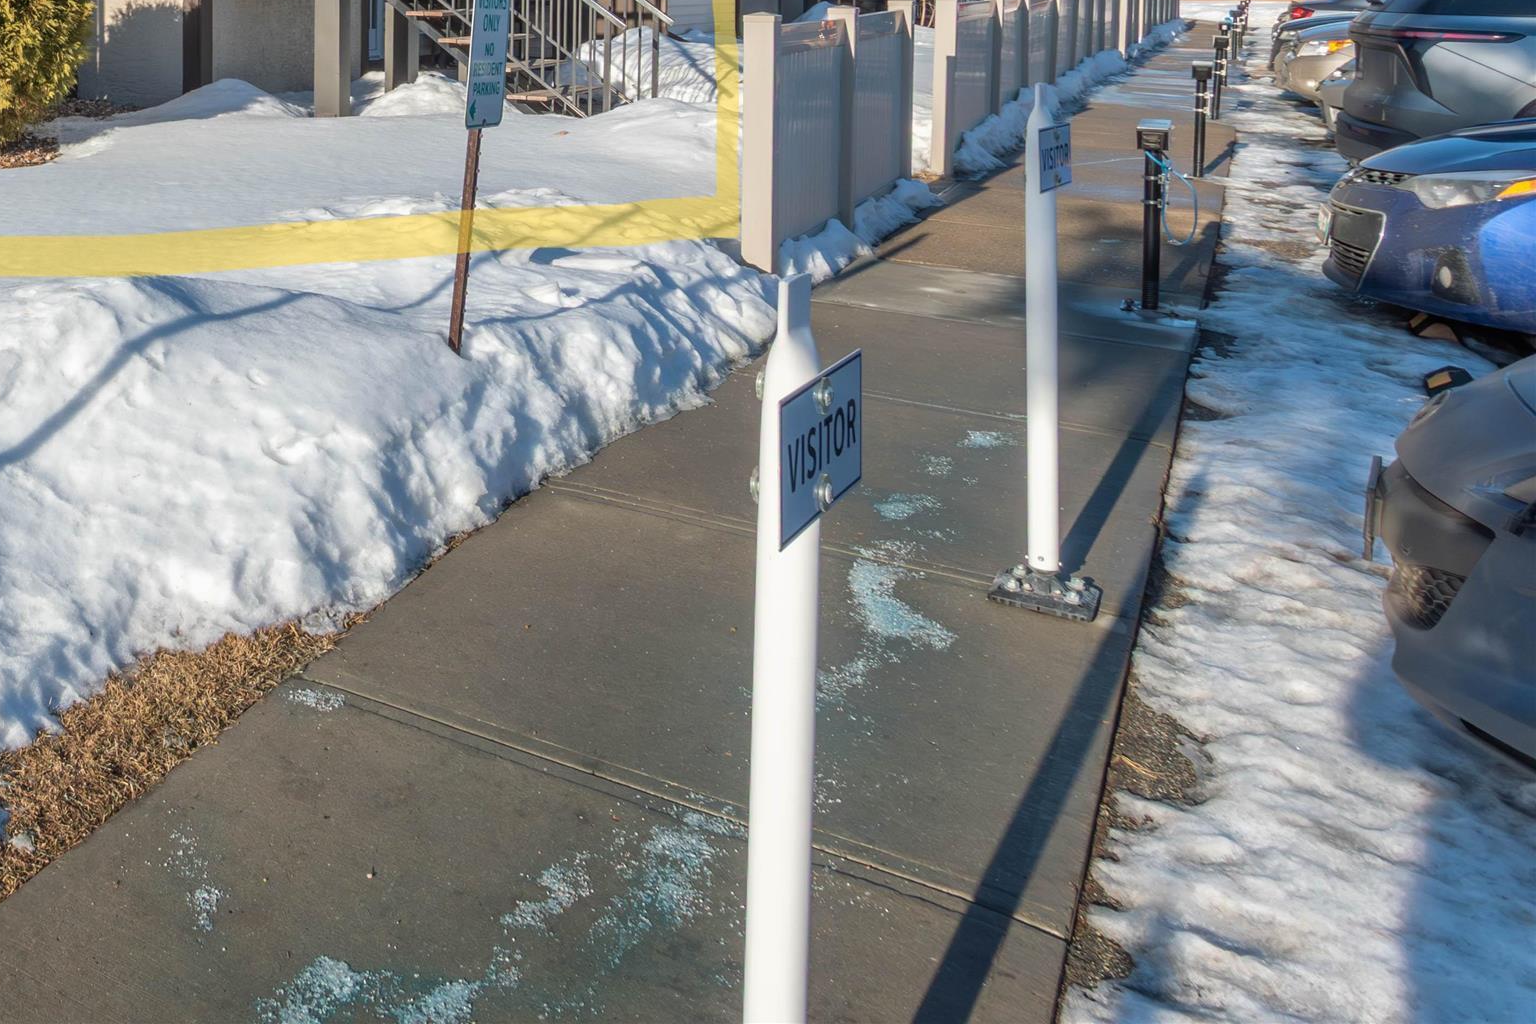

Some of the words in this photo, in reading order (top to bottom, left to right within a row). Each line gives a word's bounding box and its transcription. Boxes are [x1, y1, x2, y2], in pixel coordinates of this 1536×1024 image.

[483, 14, 500, 32] ONLY
[484, 42, 494, 56] NO
[473, 62, 503, 76] RESIDENT
[473, 81, 500, 96] PARKING
[1041, 143, 1069, 172] VISITOR
[787, 398, 857, 493] VISITOR
